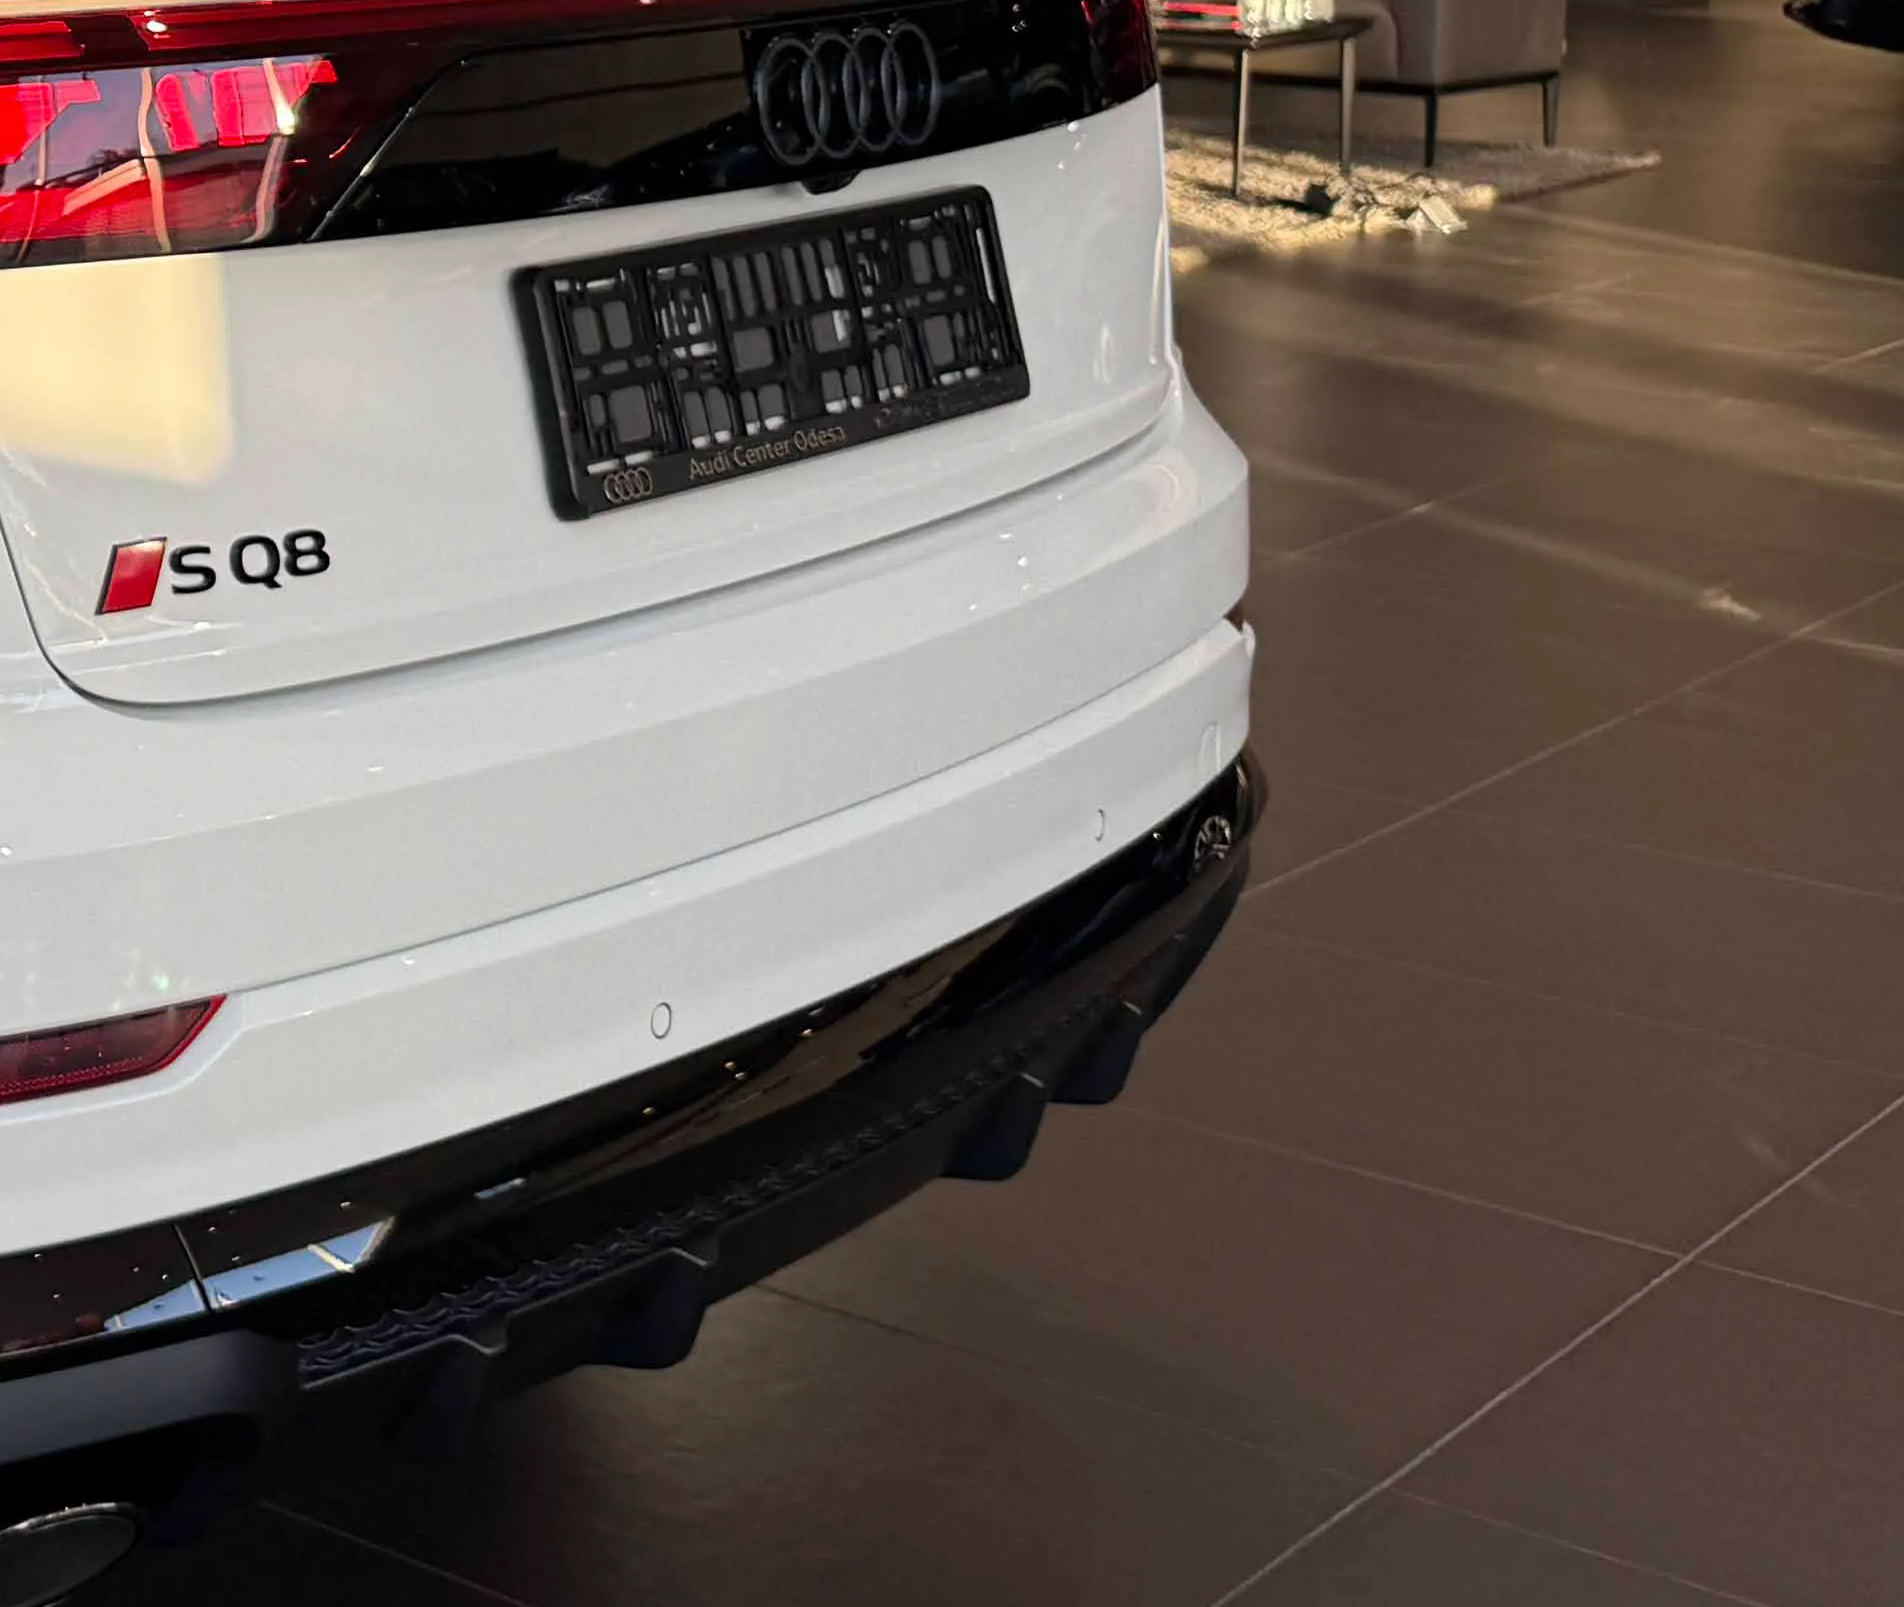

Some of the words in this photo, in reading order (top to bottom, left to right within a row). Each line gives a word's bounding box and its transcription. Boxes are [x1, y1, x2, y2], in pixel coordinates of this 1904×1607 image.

[689, 449, 730, 479] Audi
[733, 438, 791, 467] Center
[793, 425, 846, 452] Odesa
